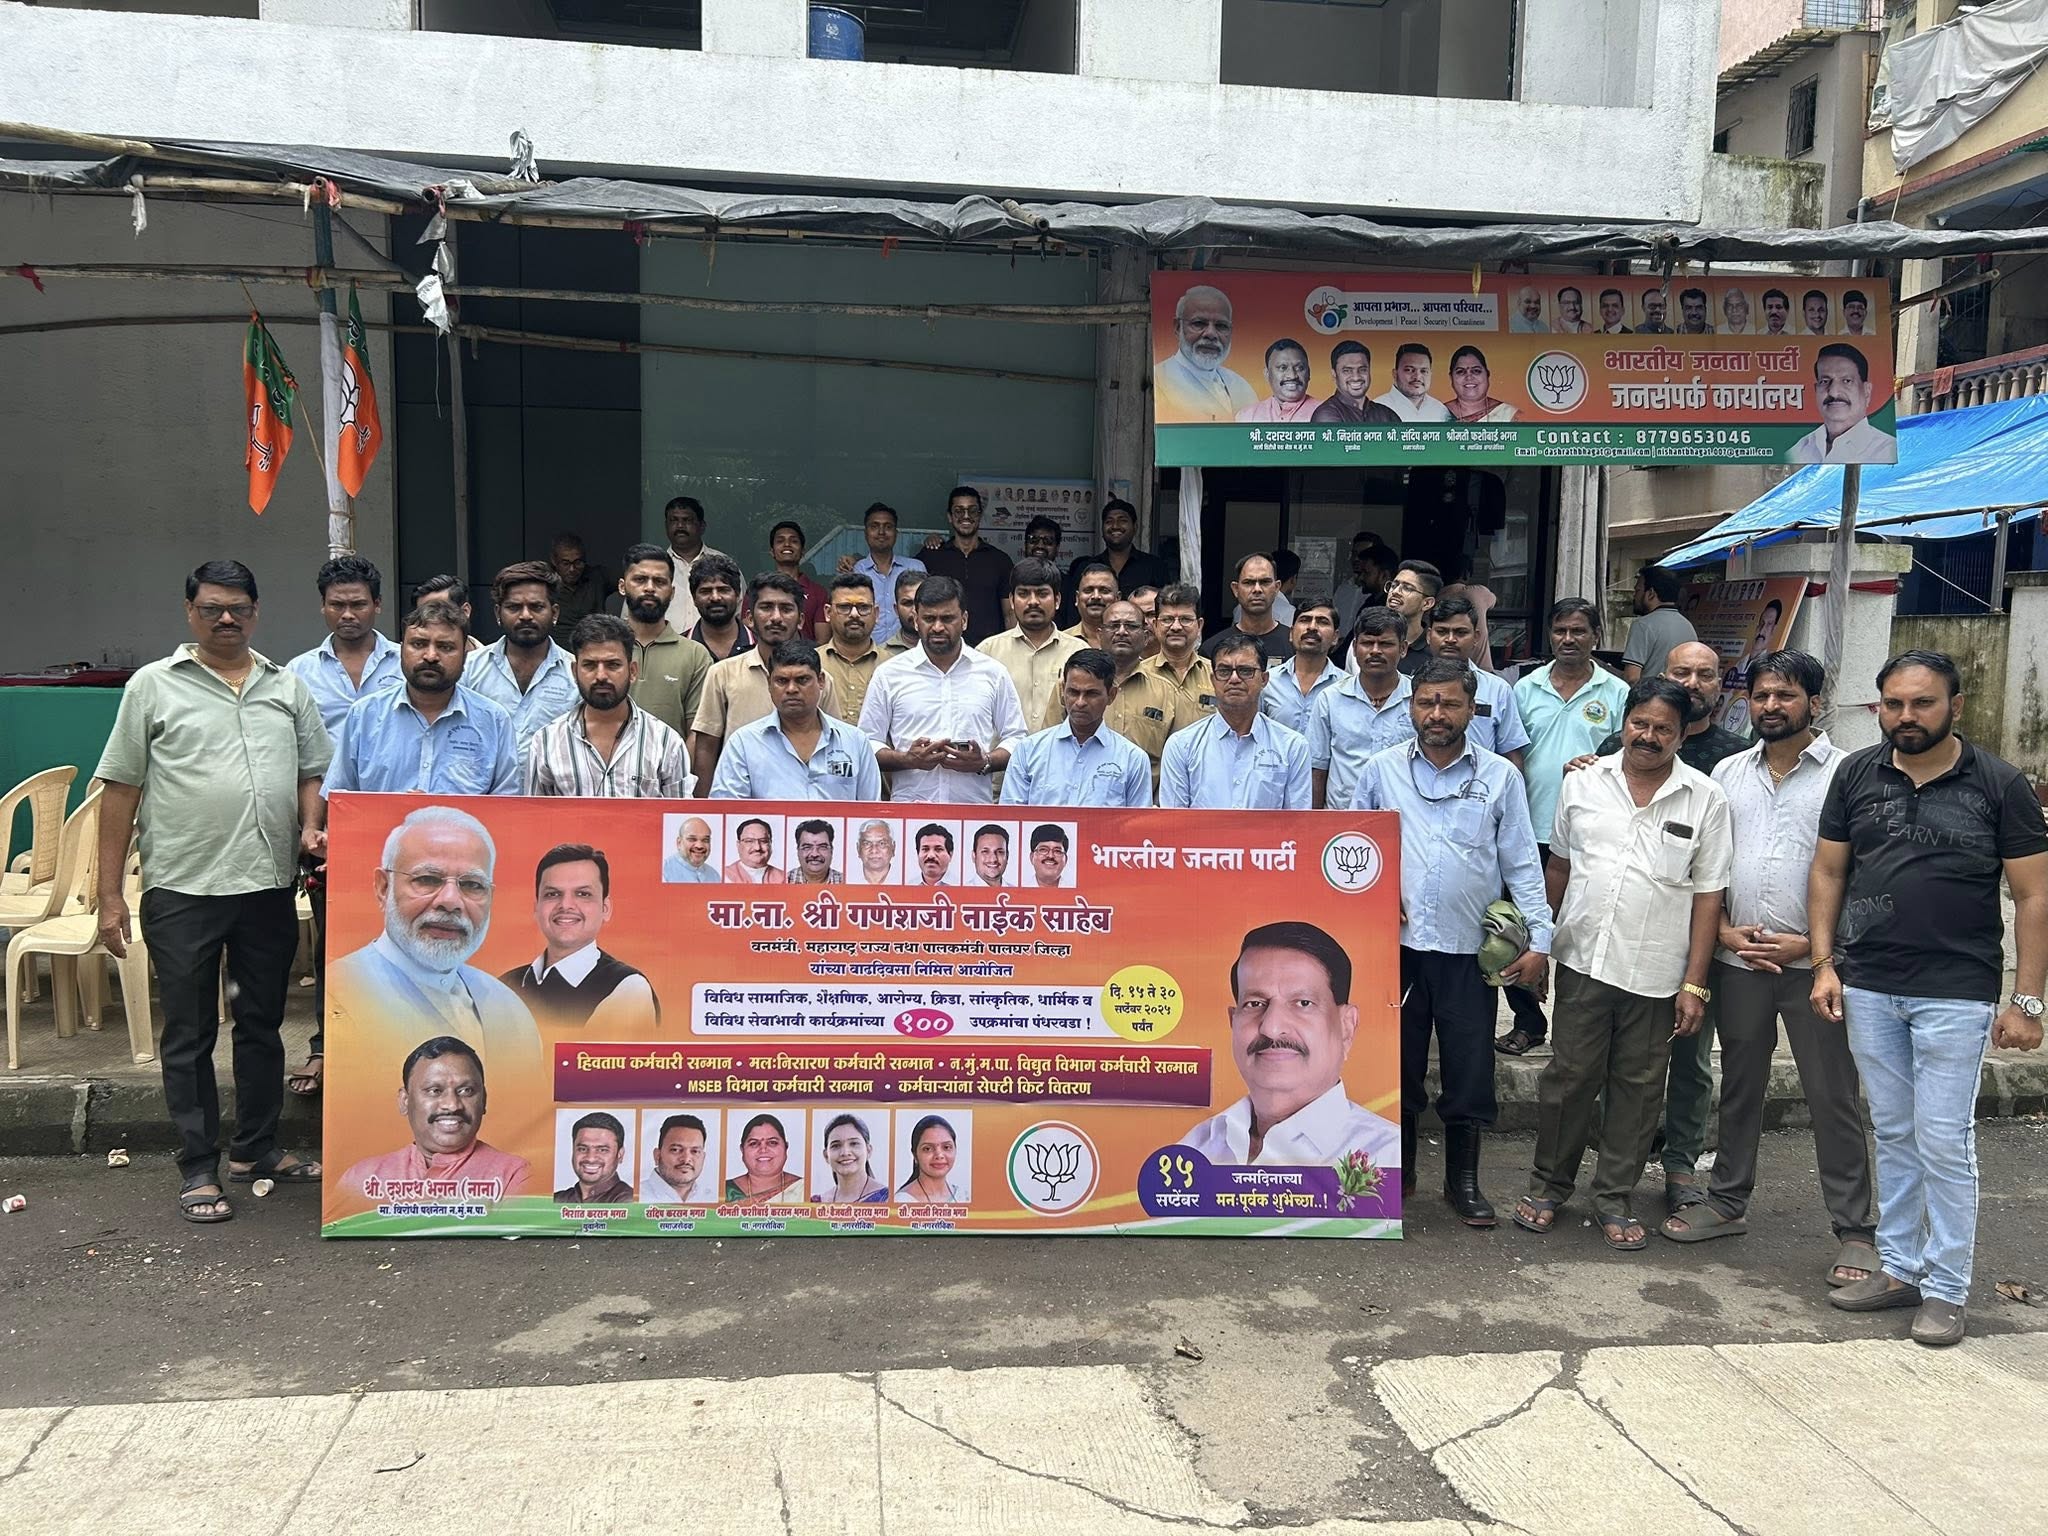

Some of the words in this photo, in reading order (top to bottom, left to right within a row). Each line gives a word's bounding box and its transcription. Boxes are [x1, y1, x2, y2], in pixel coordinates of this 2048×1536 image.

[1353, 301, 1382, 313] आपला
[1422, 301, 1451, 313] आपला
[1355, 316, 1393, 326] Development
[1400, 316, 1418, 325] Peace
[1424, 316, 1448, 327] Security
[1452, 316, 1485, 326] Cleanliness
[1605, 344, 1685, 371] भारतीय
[1689, 349, 1751, 371] जनता
[1757, 346, 1800, 371] पार्टी
[1608, 376, 1708, 410] जनसंपर्क
[1710, 376, 1805, 410] कार्यालय
[1250, 428, 1263, 442] श्री.
[1266, 431, 1293, 441] दशरथ
[1295, 431, 1315, 441] भगत
[1322, 430, 1334, 442] श्री.
[1337, 429, 1361, 442] निशांत
[1364, 431, 1382, 442] भगत
[1387, 429, 1398, 442] श्री.
[1422, 431, 1440, 441] भगत
[1446, 429, 1469, 442] श्रीमती
[1500, 431, 1517, 441] भगत
[1537, 430, 1610, 444] Contact
[1636, 430, 1751, 444] 8779653046
[1515, 447, 1536, 456] Email
[1887, 820, 1940, 846] EARN
[1091, 839, 1176, 869] भारतीय
[1182, 848, 1244, 870] जनता
[1250, 840, 1296, 871] पार्टी
[708, 903, 794, 928] मा.ना.
[803, 890, 841, 929] श्री
[848, 893, 956, 930] गणेशजी
[962, 894, 1035, 935] नाईक
[1041, 897, 1112, 933] साहेब
[806, 941, 856, 955] महाराष्ट्र
[860, 941, 889, 953] राज्य
[894, 942, 919, 953] तथा
[923, 940, 984, 954] पालकमंत्री
[989, 944, 1031, 954] पालघर
[1035, 941, 1071, 956] जिल्हा
[810, 959, 846, 975] यांच्या
[850, 961, 911, 977] वाढदिवसा
[914, 961, 953, 976] निमित्त
[958, 962, 1013, 976] आयोजित
[704, 989, 744, 1004] विविध
[748, 989, 812, 1005] सामाजिक,
[816, 989, 872, 1005] शैक्षणिक,
[876, 990, 926, 1006] आरोग्य,
[931, 991, 965, 1006] क्रिडा,
[969, 991, 1033, 1009] सांस्कृतिक,
[1038, 992, 1079, 1006] धार्मिक
[1083, 996, 1093, 1006] व
[1110, 983, 1124, 999] दि.
[1129, 986, 1144, 998] १५
[1147, 984, 1156, 997] ते
[1160, 987, 1176, 999] ३०
[1145, 1005, 1171, 1015] २०२५
[704, 1012, 744, 1026] विविध
[749, 1012, 805, 1027] सेवाभावी
[809, 1011, 885, 1028] कार्यक्रमांच्या
[902, 1013, 948, 1033] १००
[970, 1014, 1029, 1028] उपक्रमांचा
[1033, 1014, 1081, 1029] पंधरवडा
[577, 1051, 626, 1072] हिवताप
[630, 1051, 683, 1070] कर्मचारी
[687, 1057, 732, 1070] सन्मान
[834, 1052, 886, 1070] कर्मचारी
[890, 1057, 934, 1070] सन्मान
[949, 1053, 1012, 1076] न.मुं.म.पा.
[1017, 1054, 1051, 1076] विद्युत
[1056, 1054, 1095, 1072] विभाग
[1100, 1055, 1151, 1074] कर्मचारी
[1155, 1061, 1198, 1074] सन्मान
[688, 1080, 722, 1093] MSEB
[726, 1075, 769, 1093] विभाग
[773, 1074, 825, 1093] कर्मचारी
[829, 1080, 873, 1093] सन्मान
[977, 1076, 1013, 1094] सेफ्टी
[1017, 1076, 1044, 1094] किट
[1048, 1077, 1091, 1095] वितरण
[1159, 1154, 1194, 1188] १५
[1232, 1169, 1302, 1187] जन्मदिनाच्या
[365, 1176, 382, 1198] श्री.
[387, 1181, 423, 1200] दशरथ
[427, 1180, 457, 1197] भगत
[461, 1178, 500, 1200] (नाना)
[1156, 1189, 1200, 1207] सप्टेंबर
[1216, 1188, 1269, 1213] मनःपूर्वक
[379, 1206, 390, 1214] मा.
[393, 1203, 419, 1214] विरोधी
